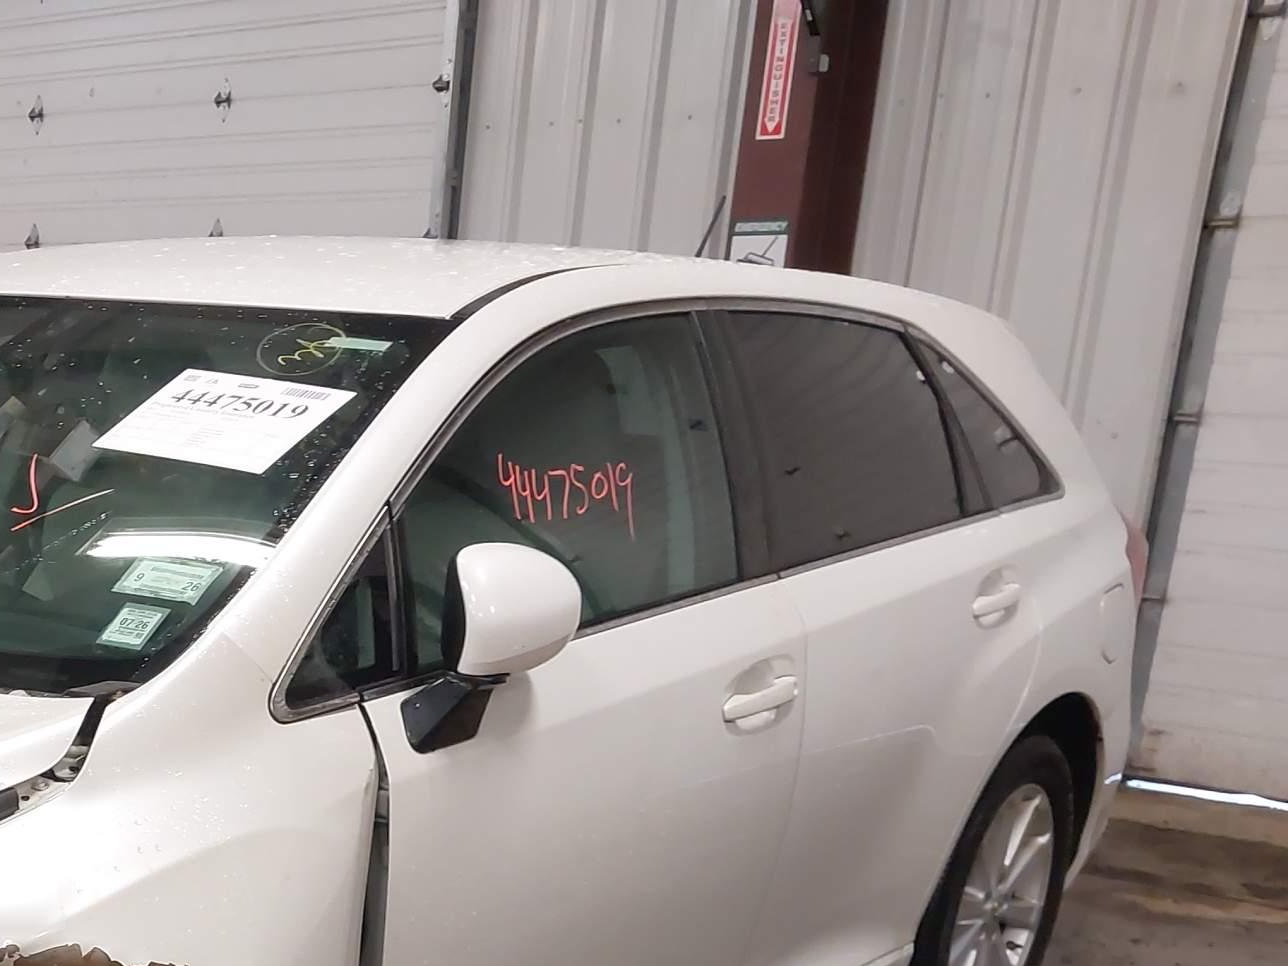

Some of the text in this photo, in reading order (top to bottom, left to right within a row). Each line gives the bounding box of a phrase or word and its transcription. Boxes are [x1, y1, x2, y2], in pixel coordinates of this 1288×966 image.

[171, 388, 309, 418] 44475019
[497, 453, 636, 541] 44475019
[133, 573, 145, 582] 9
[182, 581, 202, 592] 26
